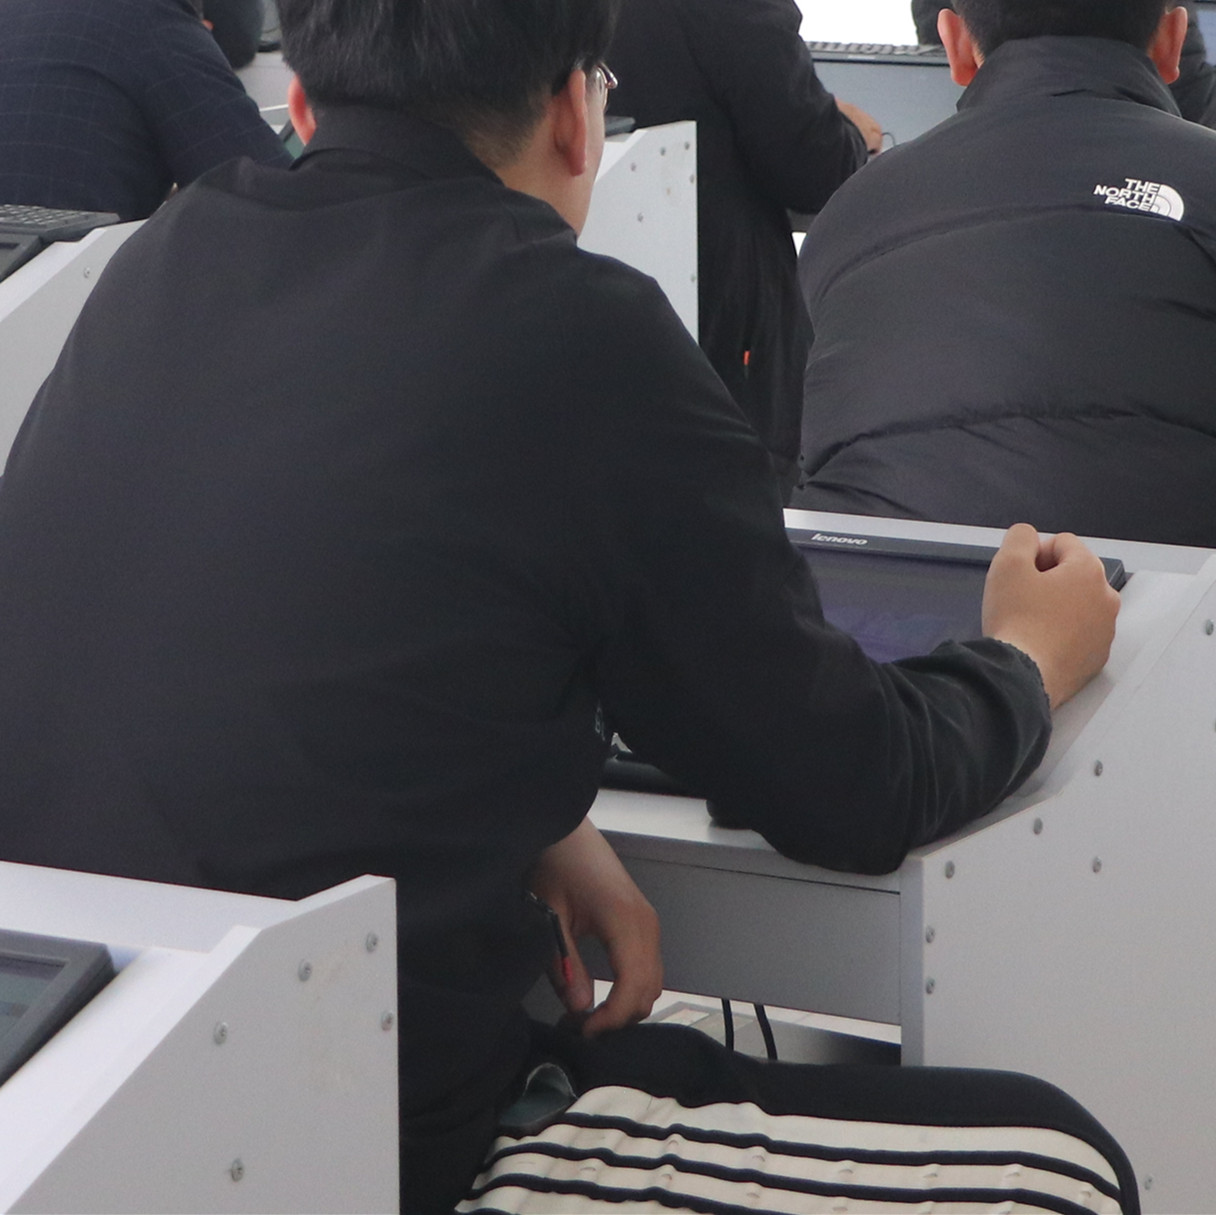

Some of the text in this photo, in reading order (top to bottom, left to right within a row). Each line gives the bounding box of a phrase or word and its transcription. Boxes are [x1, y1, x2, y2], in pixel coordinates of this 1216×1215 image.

[1124, 177, 1161, 194] THE
[1093, 184, 1157, 204] NORTH
[1104, 196, 1153, 212] FACE
[810, 532, 869, 546] lenovo
